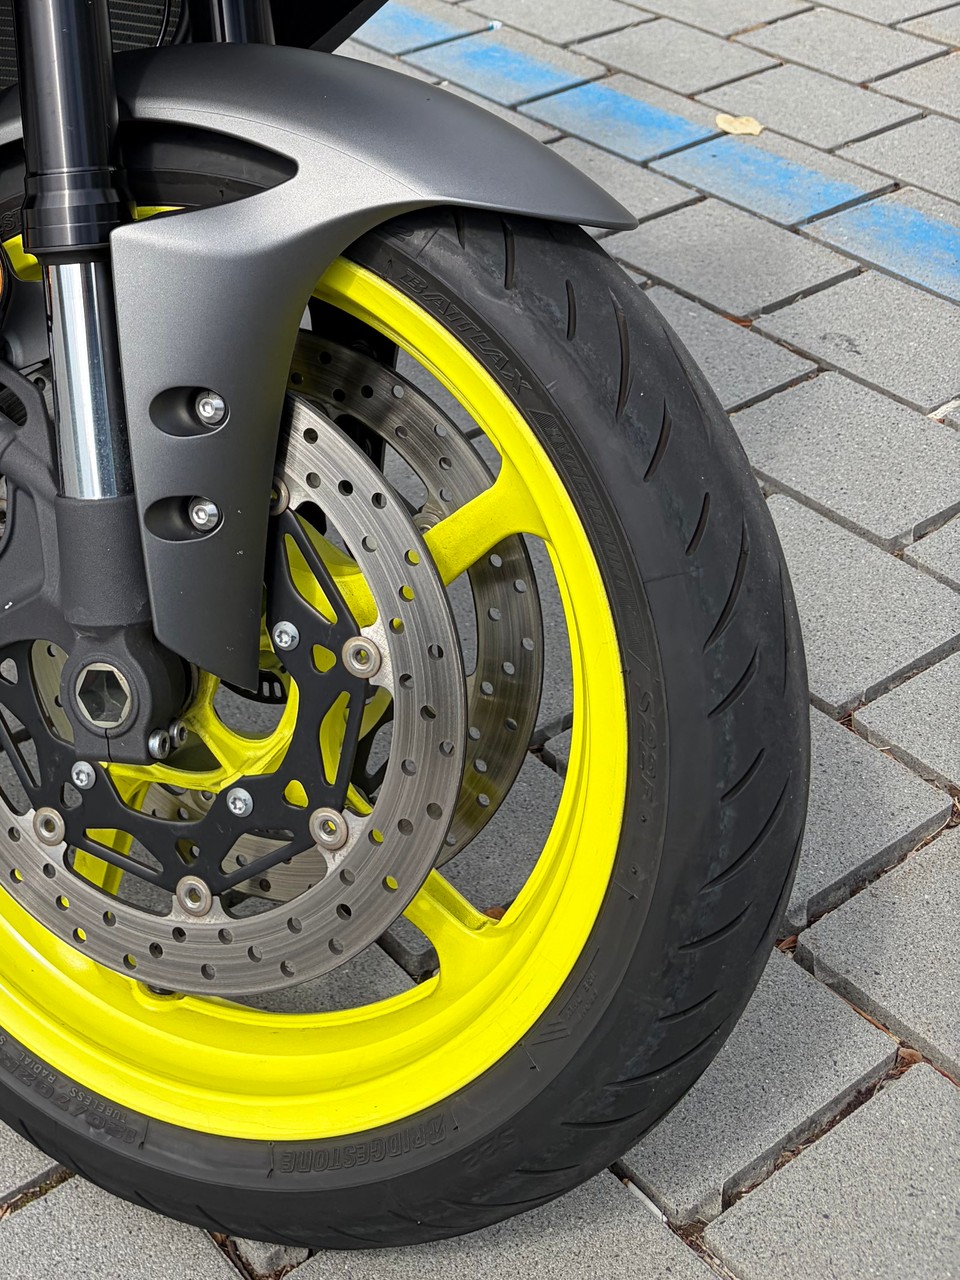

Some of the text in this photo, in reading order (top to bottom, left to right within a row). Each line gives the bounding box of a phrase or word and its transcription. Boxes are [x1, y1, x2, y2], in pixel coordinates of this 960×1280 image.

[399, 269, 533, 396] BATTLAX
[16, 1050, 58, 1084] RADIAL
[68, 1086, 128, 1123] TUBELESS
[278, 1112, 446, 1173] BRIDGESTONE
